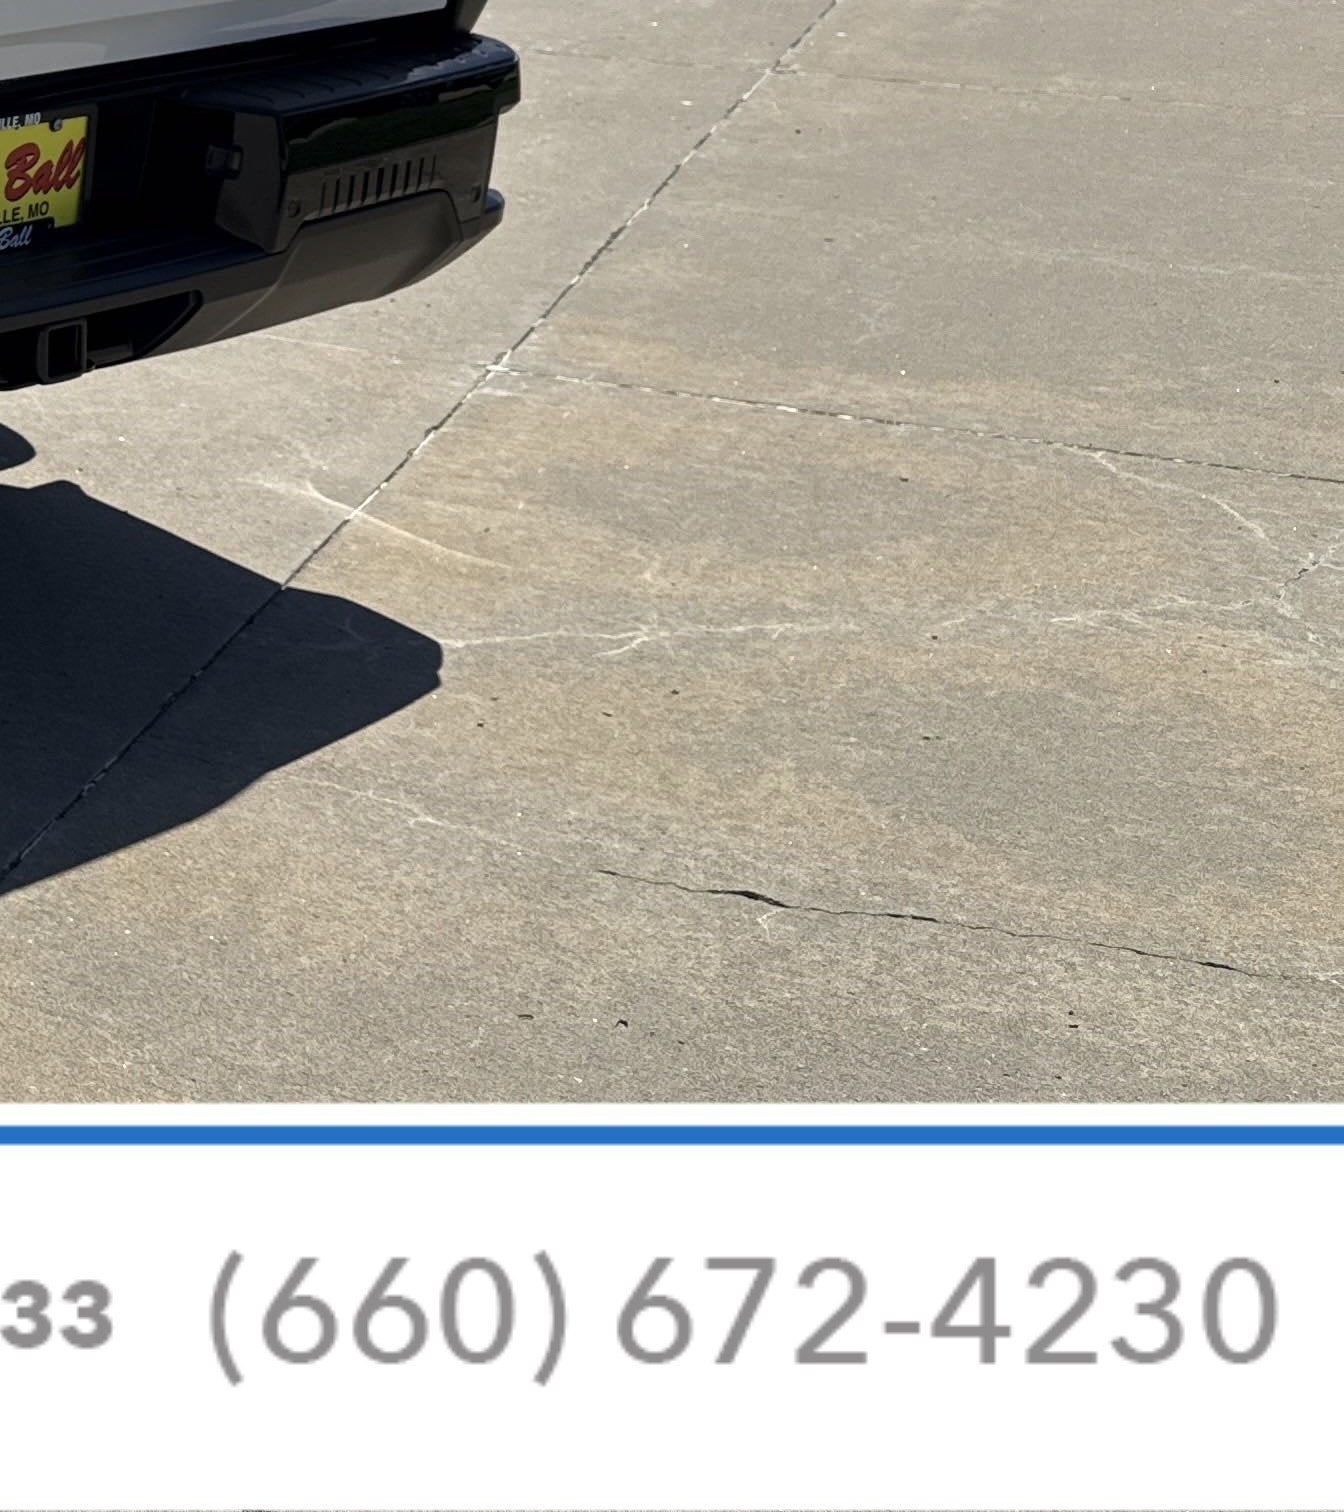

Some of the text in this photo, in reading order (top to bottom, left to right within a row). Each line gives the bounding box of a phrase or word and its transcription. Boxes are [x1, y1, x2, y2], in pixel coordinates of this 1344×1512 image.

[25, 112, 41, 126] MO
[4, 137, 86, 201] Ball
[28, 201, 50, 217] MO
